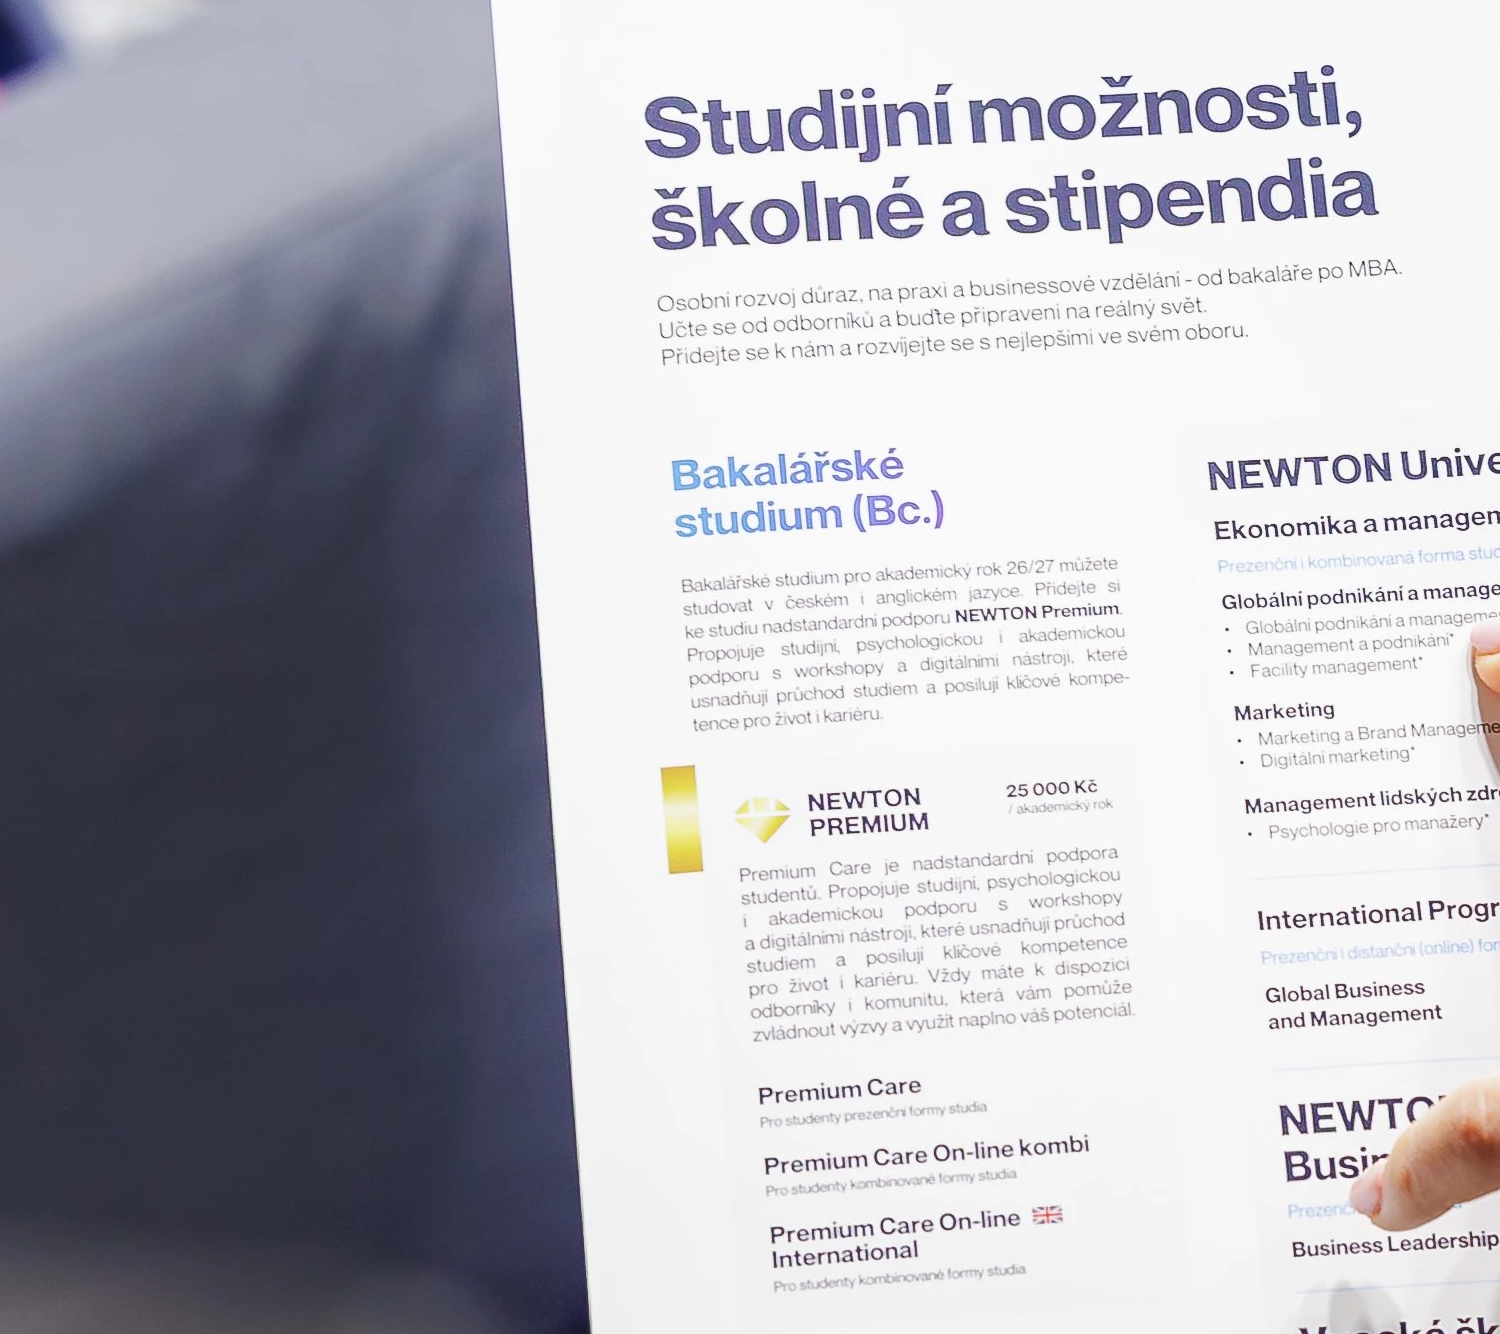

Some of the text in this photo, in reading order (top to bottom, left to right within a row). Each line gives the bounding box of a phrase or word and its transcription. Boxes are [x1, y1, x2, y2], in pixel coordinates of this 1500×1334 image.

[645, 65, 1362, 162] Studijní možnosti,
[652, 157, 1379, 250] školné a stipendia
[662, 346, 740, 366] Přidejte
[746, 348, 769, 360] se
[775, 343, 786, 358] k
[792, 341, 834, 358] nám
[840, 344, 852, 356] a
[951, 338, 974, 351] se
[980, 338, 990, 350] s
[1099, 332, 1121, 344] ve
[1128, 325, 1180, 343] svém
[1185, 323, 1248, 340] oboru.
[672, 448, 904, 491] Bakalářské
[1208, 452, 1392, 490] NEWTON
[675, 490, 943, 537] studium (Bc.)
[1214, 516, 1357, 540] Ekonomika
[1364, 519, 1378, 532] a
[1222, 591, 1302, 609] Globální
[1307, 586, 1403, 609] podnikání
[1408, 590, 1419, 600] a
[685, 626, 704, 638] ke
[709, 622, 758, 637] studiu
[882, 612, 950, 629] podporu
[955, 606, 1037, 623] NEWTON
[1042, 603, 1124, 618] Premium.
[1249, 639, 1354, 656] Management
[1359, 640, 1368, 650] a
[1251, 663, 1307, 678] Facility
[1235, 702, 1334, 721] Marketing
[1259, 731, 1340, 745] Marketing
[1345, 731, 1354, 741] a
[1358, 725, 1406, 740] Brand
[808, 788, 920, 811] NEWTON
[1007, 780, 1097, 797] 25 000 Kč
[1245, 793, 1376, 814] Management
[1380, 787, 1462, 806] lidských
[810, 813, 929, 836] PREMIUM
[1258, 901, 1422, 930] International
[1266, 982, 1425, 1003] Global Business
[1269, 1005, 1442, 1029] and Management
[759, 1079, 921, 1105] Premium Care
[1279, 1096, 1445, 1136] NEWTO
[765, 1135, 1089, 1175] Premium Care On-line kombi
[771, 1211, 1020, 1244] Premium Care On-line
[773, 1241, 918, 1268] International
[1292, 1231, 1499, 1257] Business Leadership
